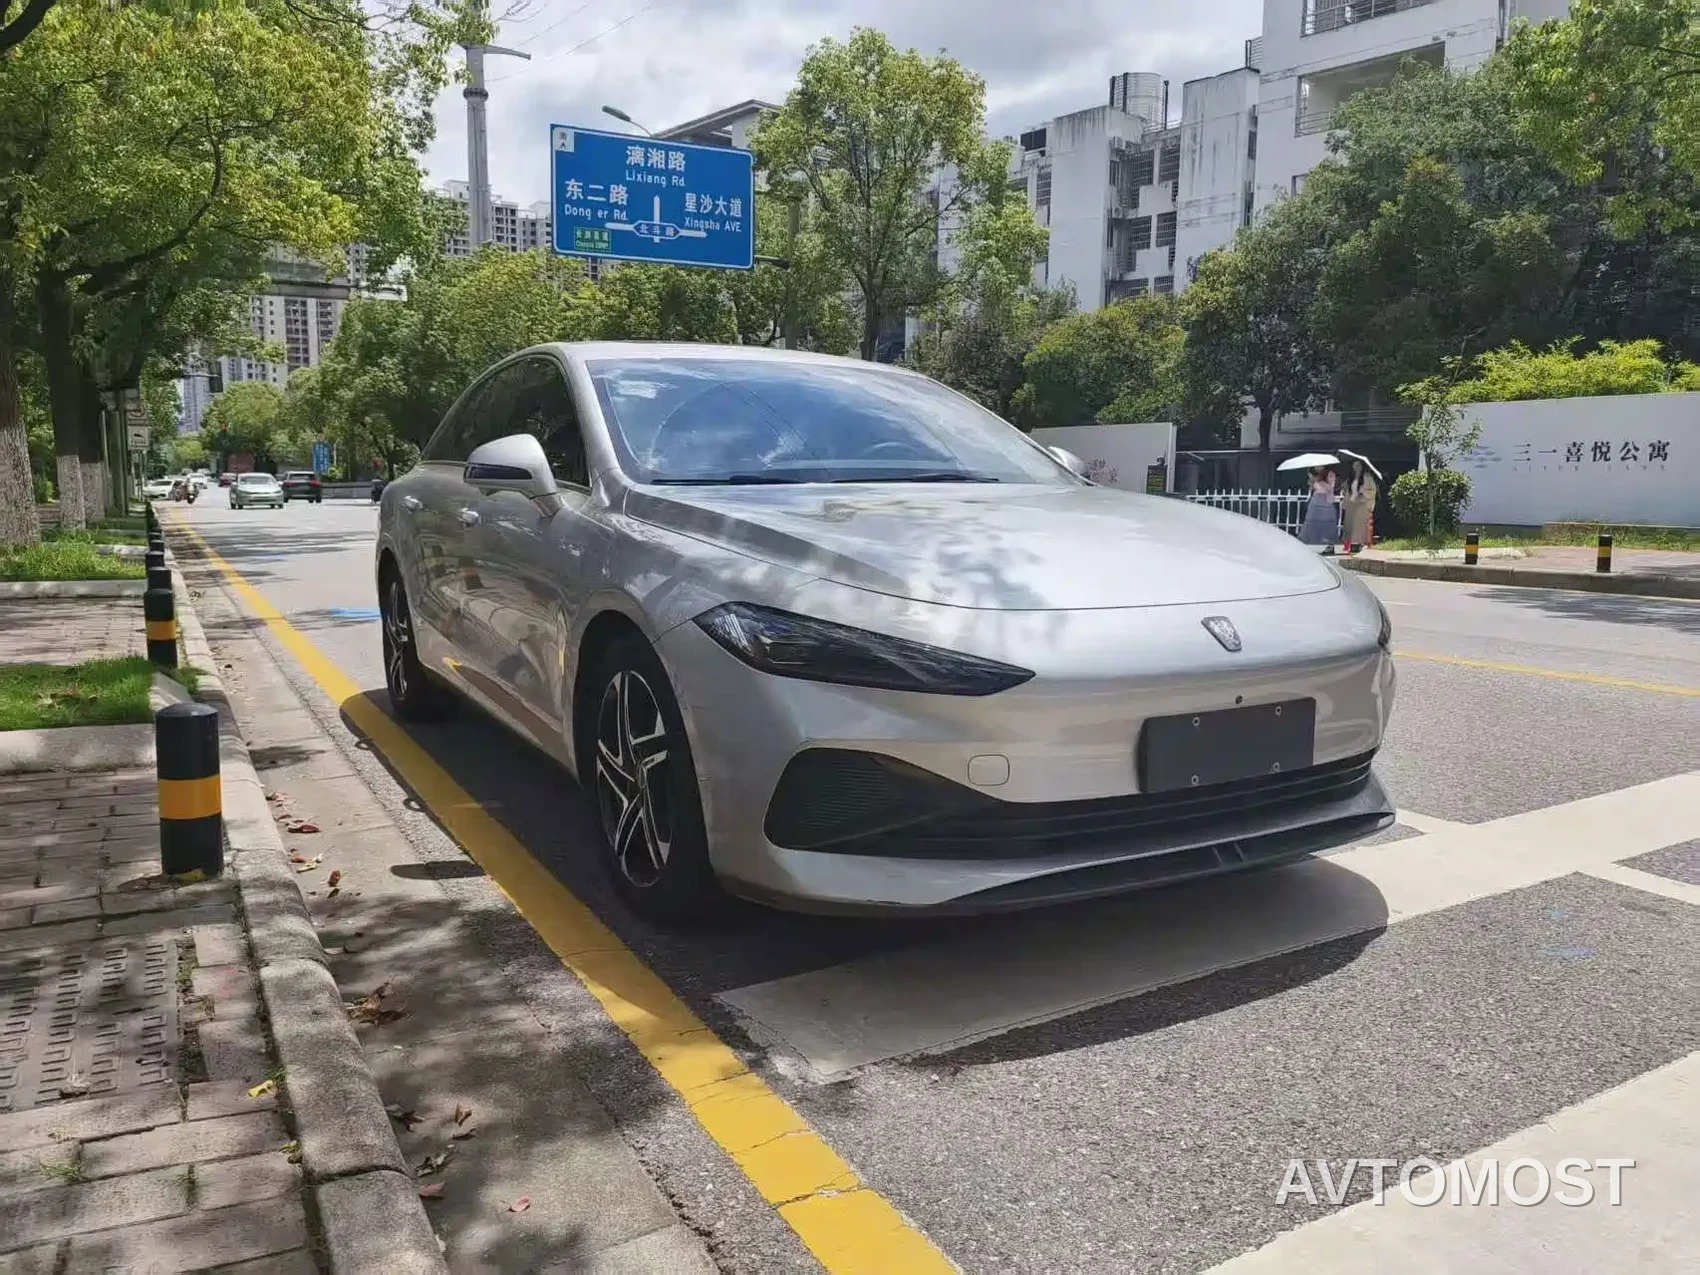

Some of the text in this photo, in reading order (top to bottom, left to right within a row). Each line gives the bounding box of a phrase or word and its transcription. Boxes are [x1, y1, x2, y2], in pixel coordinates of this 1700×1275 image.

[625, 145, 687, 172] 漓湘路
[625, 170, 667, 188] Lixiang
[564, 178, 629, 206] 东二路
[564, 203, 592, 220] Dong
[597, 208, 608, 219] er
[684, 192, 743, 218] 星沙大道
[684, 216, 720, 231] Xingsha
[1512, 439, 1671, 463] 三一喜悦公寓
